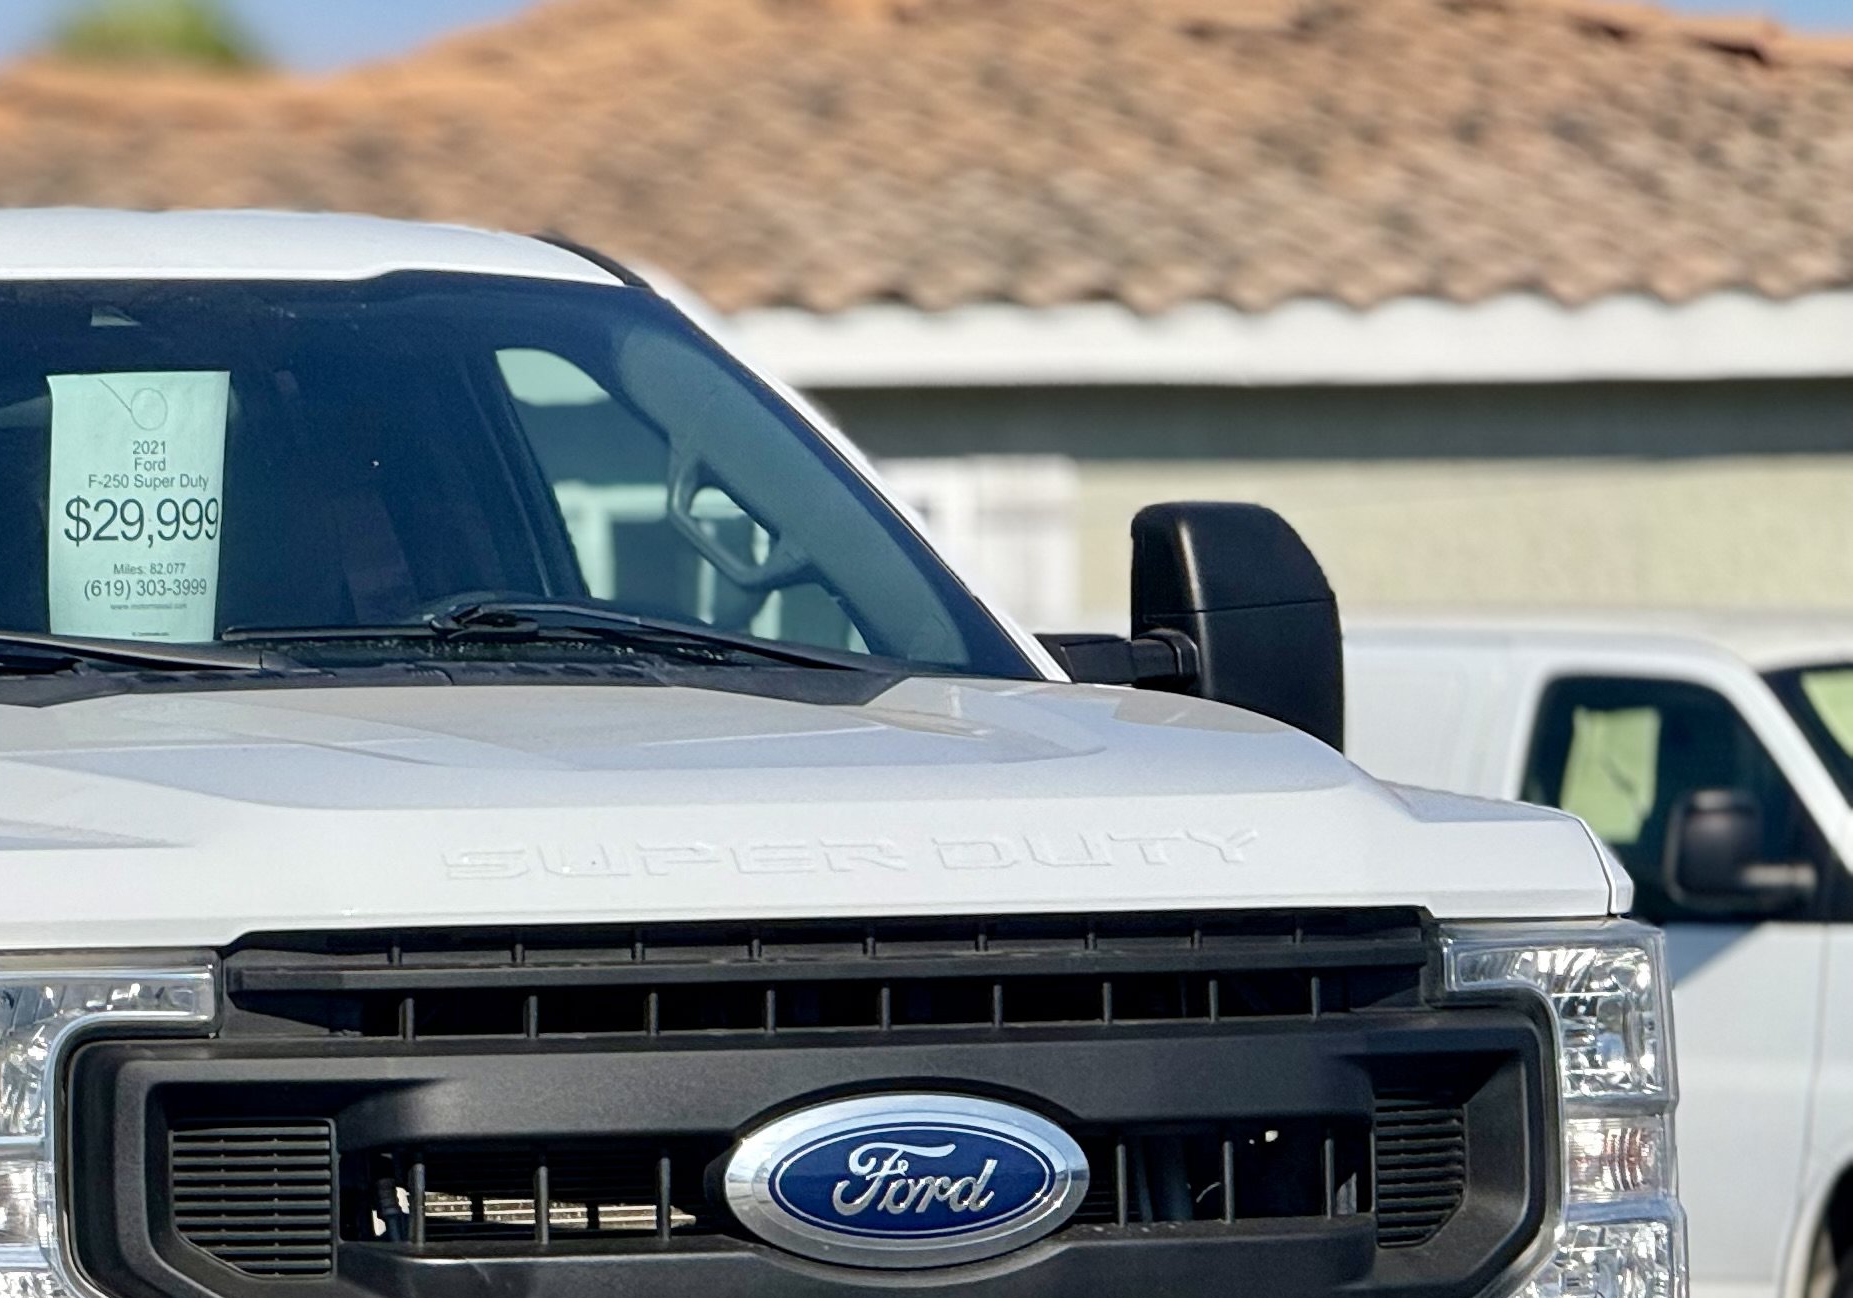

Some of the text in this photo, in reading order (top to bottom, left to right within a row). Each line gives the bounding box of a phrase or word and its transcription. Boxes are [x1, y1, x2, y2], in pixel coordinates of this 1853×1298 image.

[132, 440, 166, 455] 2021
[134, 457, 166, 471] Ford
[88, 473, 209, 492] F-250 Super Duty
[64, 495, 219, 548] $29,999
[84, 578, 207, 601] (619) 303-3999
[441, 829, 1258, 880] SUPER DUTY
[832, 1142, 998, 1216] Ford
